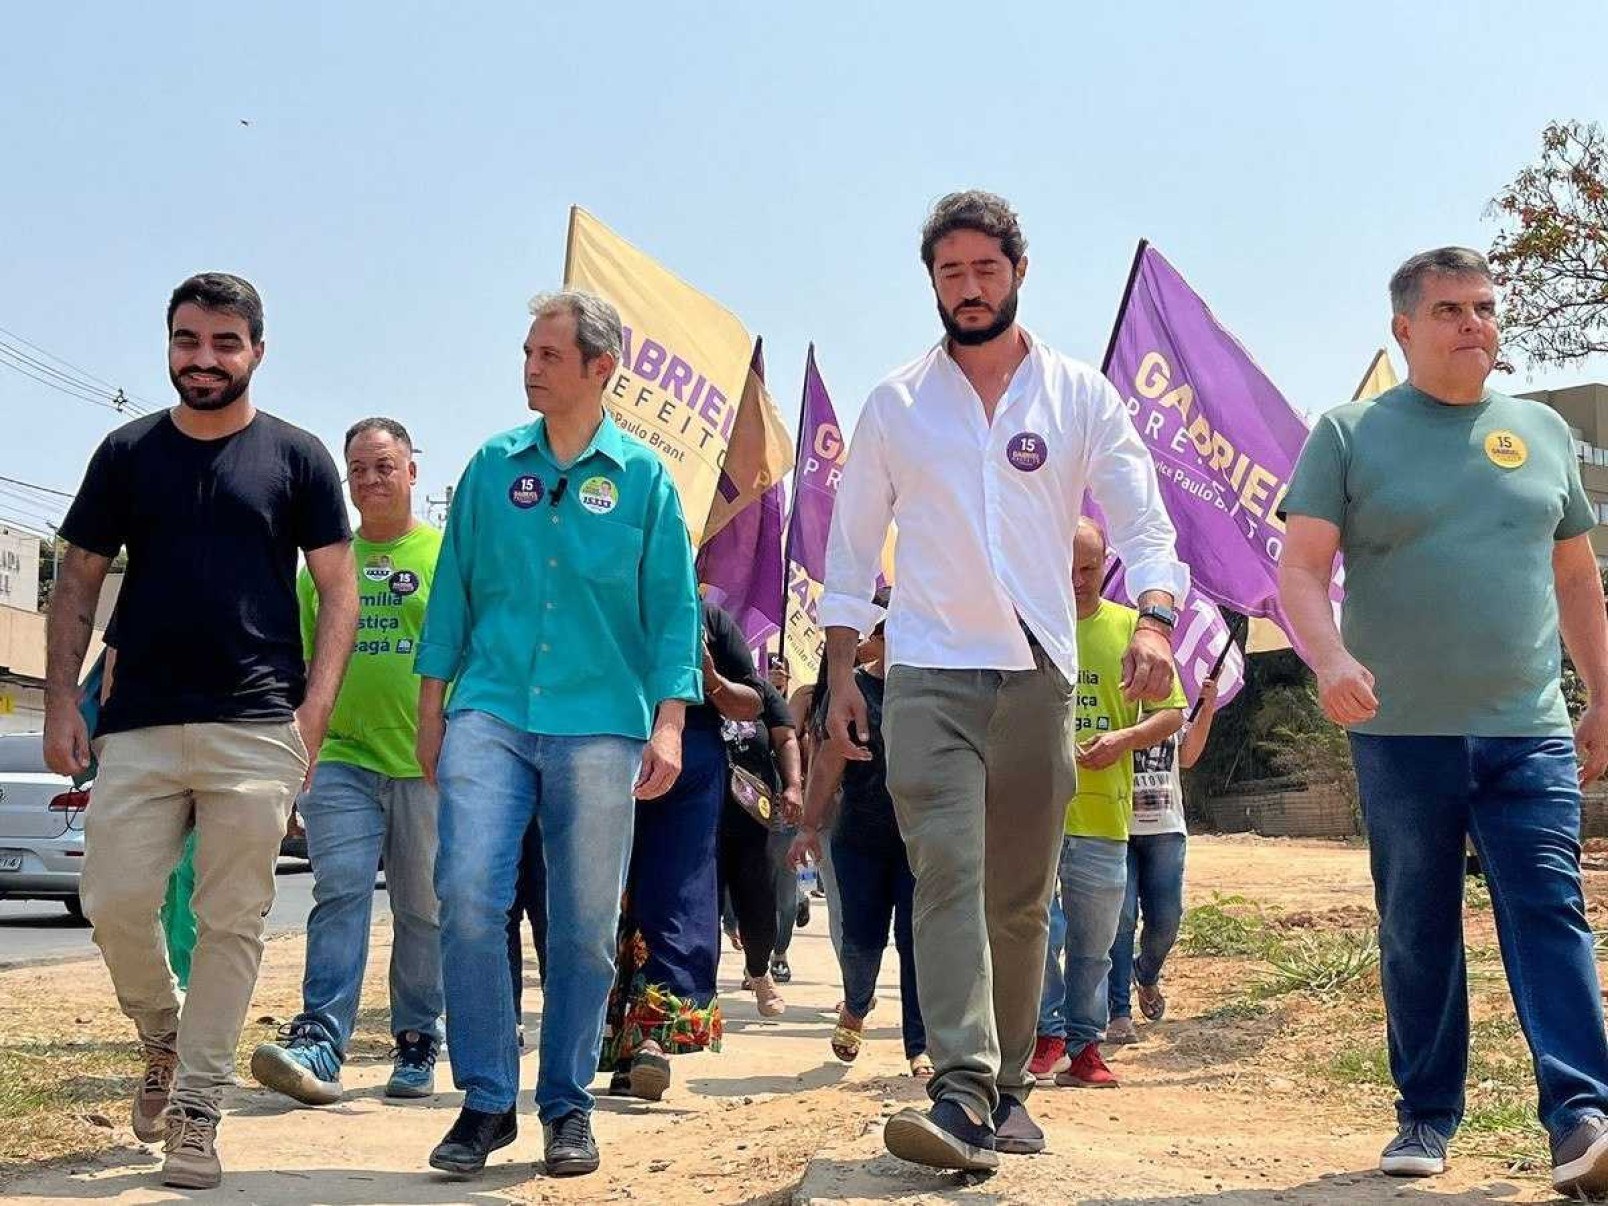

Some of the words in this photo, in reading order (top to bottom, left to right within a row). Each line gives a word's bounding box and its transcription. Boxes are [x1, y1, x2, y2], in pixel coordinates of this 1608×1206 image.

[622, 326, 735, 444] ABRIEL
[614, 413, 647, 439] Paulo
[650, 432, 686, 462] Brant
[1021, 438, 1036, 452] 15
[1498, 436, 1512, 448] 15
[521, 479, 534, 491] 15
[1174, 469, 1213, 501] Paulo
[399, 573, 411, 583] 15
[360, 591, 403, 607] mília
[358, 615, 399, 633] stiça
[1076, 693, 1097, 708] iça
